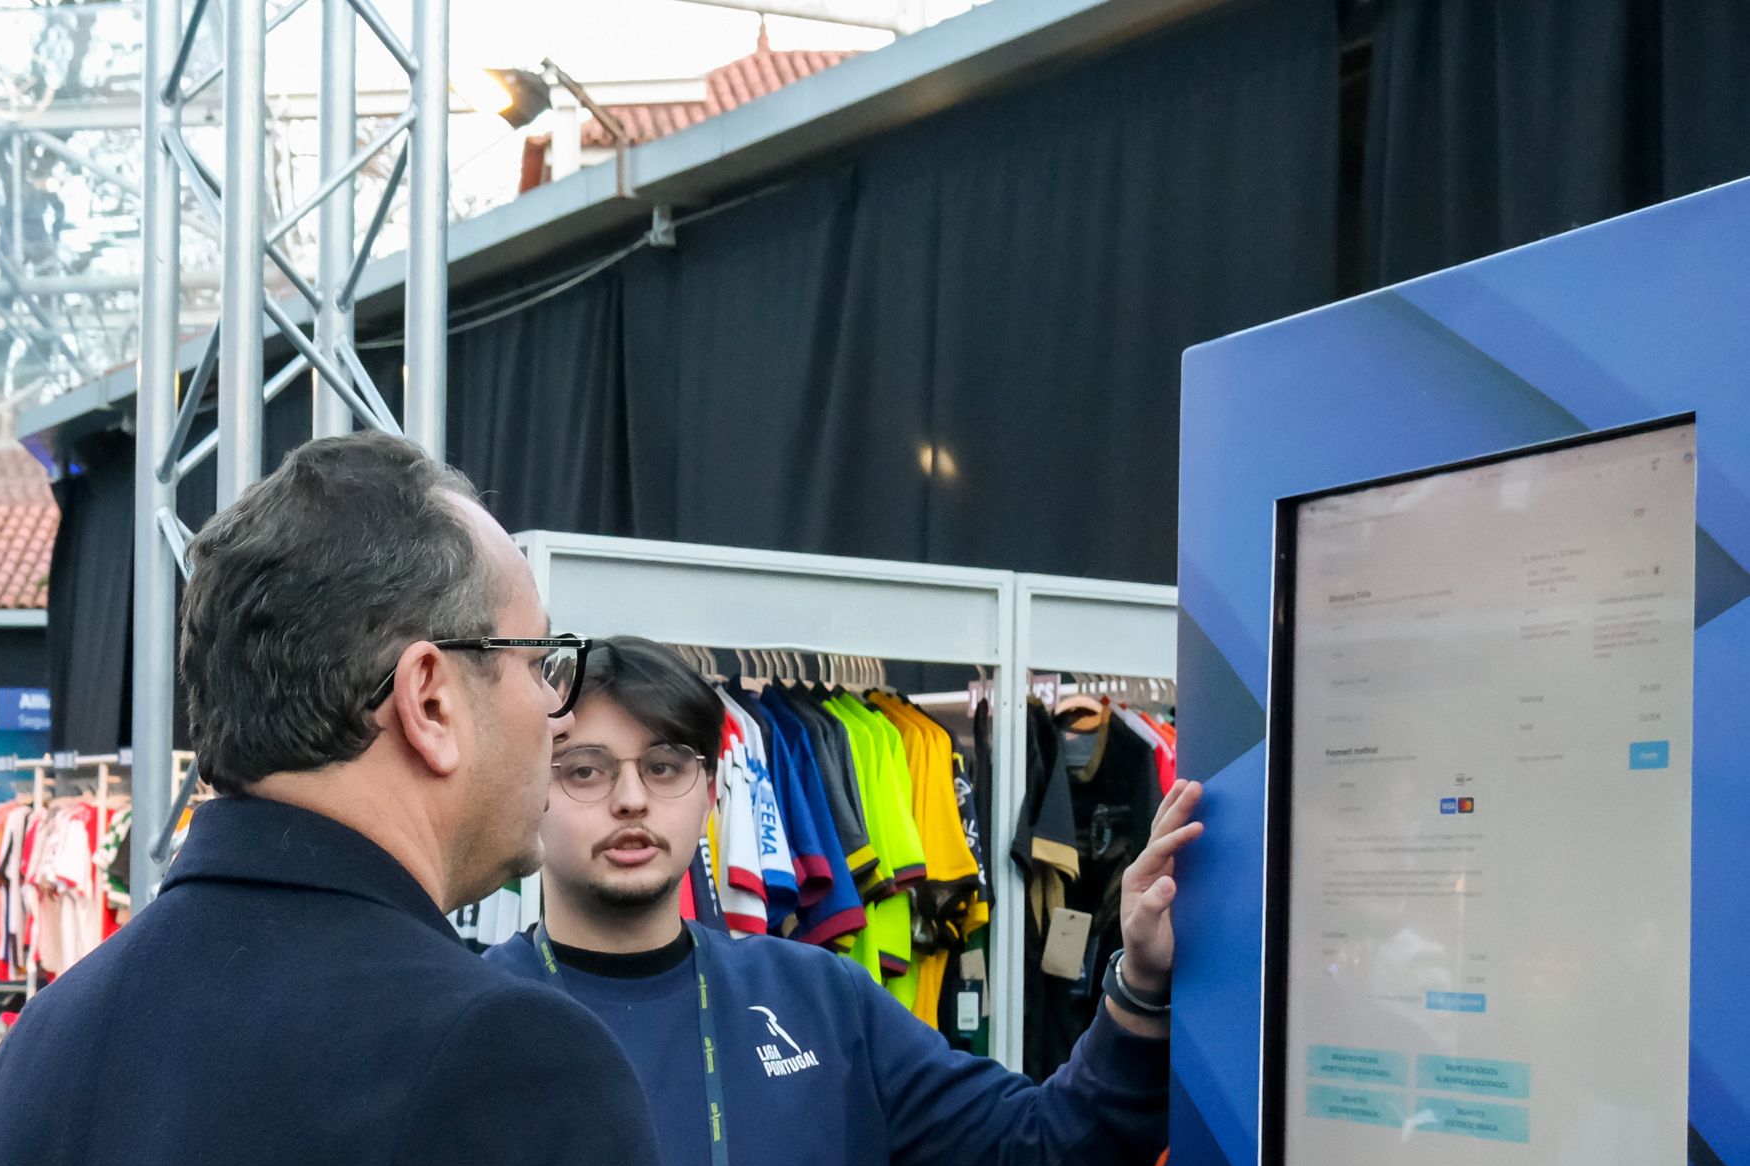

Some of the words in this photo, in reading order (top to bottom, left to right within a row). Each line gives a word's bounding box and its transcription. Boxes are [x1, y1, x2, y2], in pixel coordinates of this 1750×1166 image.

[760, 800, 778, 856] FEMA
[756, 1044, 782, 1061] LIGA
[762, 1050, 820, 1077] PORTUGAL
